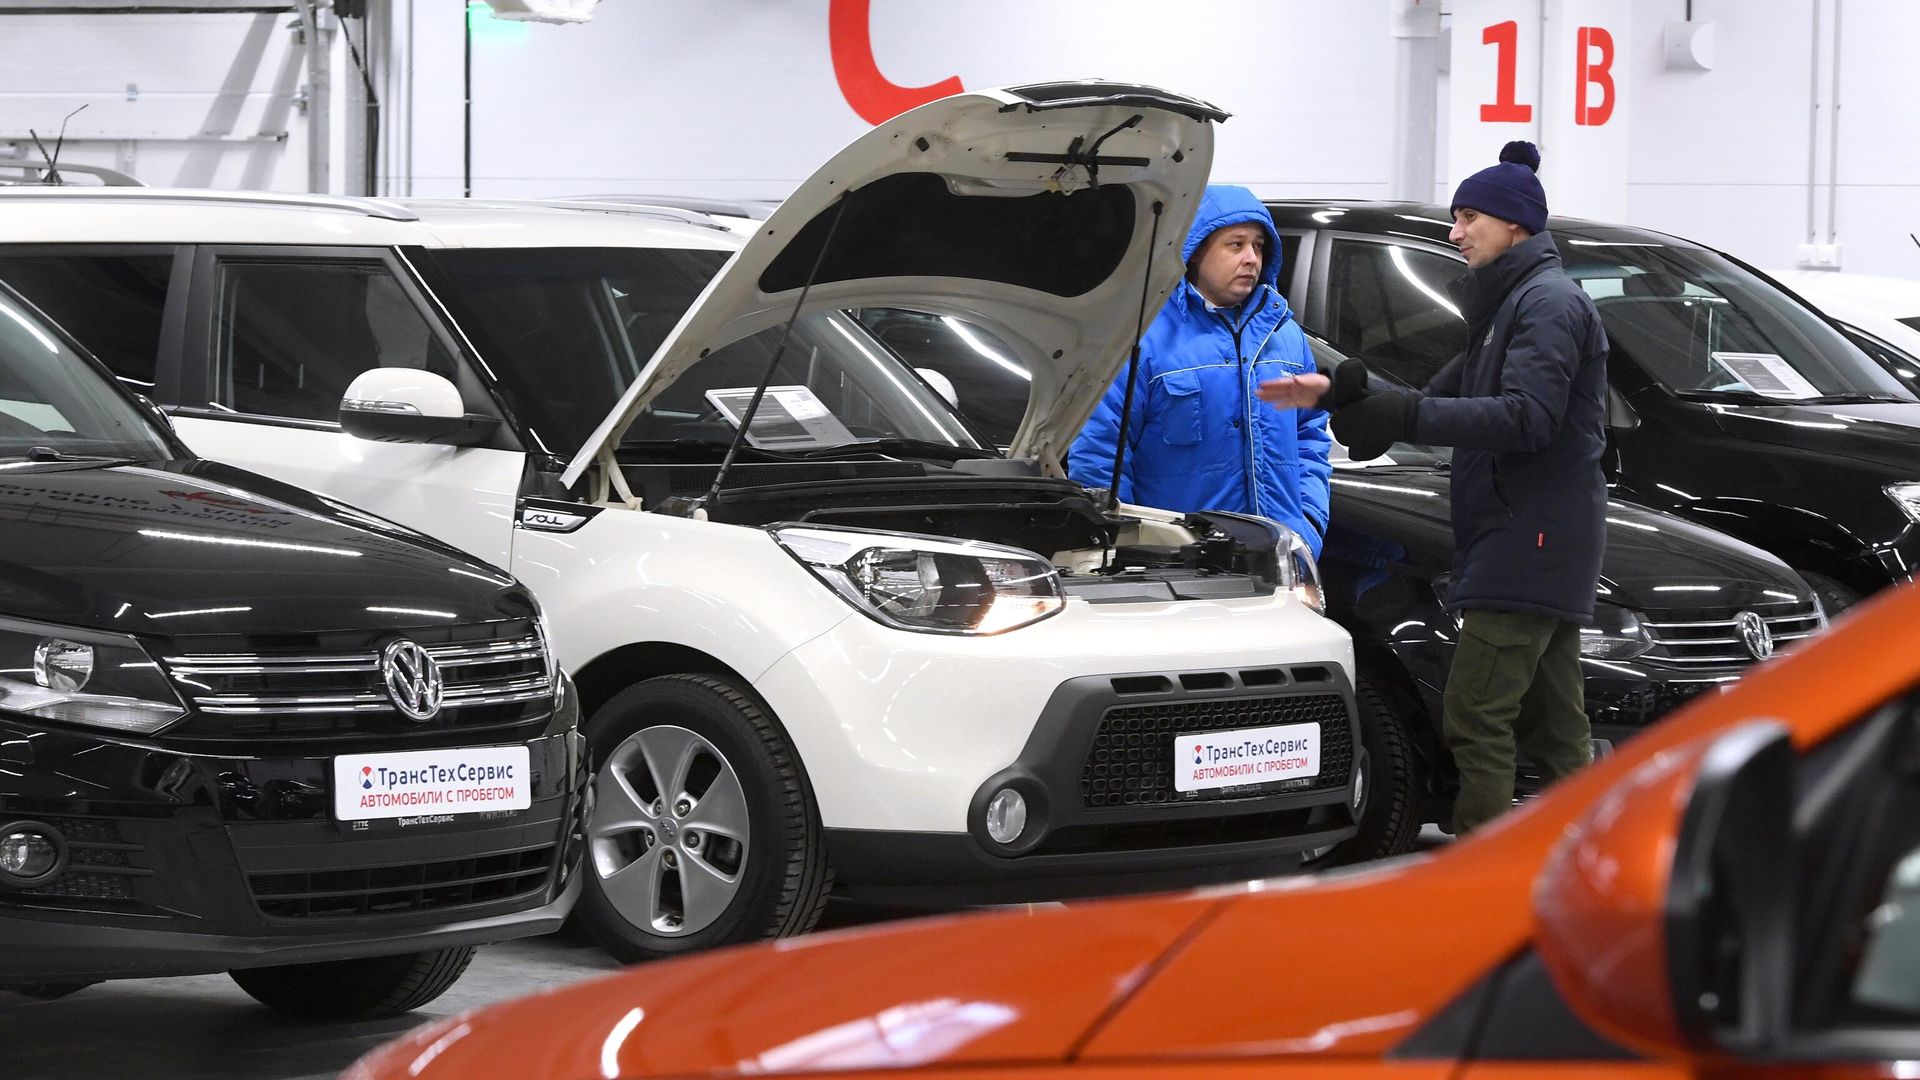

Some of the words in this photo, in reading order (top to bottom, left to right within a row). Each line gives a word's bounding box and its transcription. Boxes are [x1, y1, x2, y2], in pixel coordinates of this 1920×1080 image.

[1480, 20, 1532, 123] 1
[1575, 26, 1615, 126] B
[1206, 738, 1308, 764] ТрансТехСервис
[378, 763, 513, 790] ТрансТехСервис
[1192, 763, 1254, 781] АВТОМОБИЛИ
[1264, 757, 1308, 772] ПРОБЕГОМ
[360, 790, 443, 808] АВТОМОБИЛИ
[446, 791, 454, 803] С
[456, 787, 514, 802] ПРОБЕГОМ
